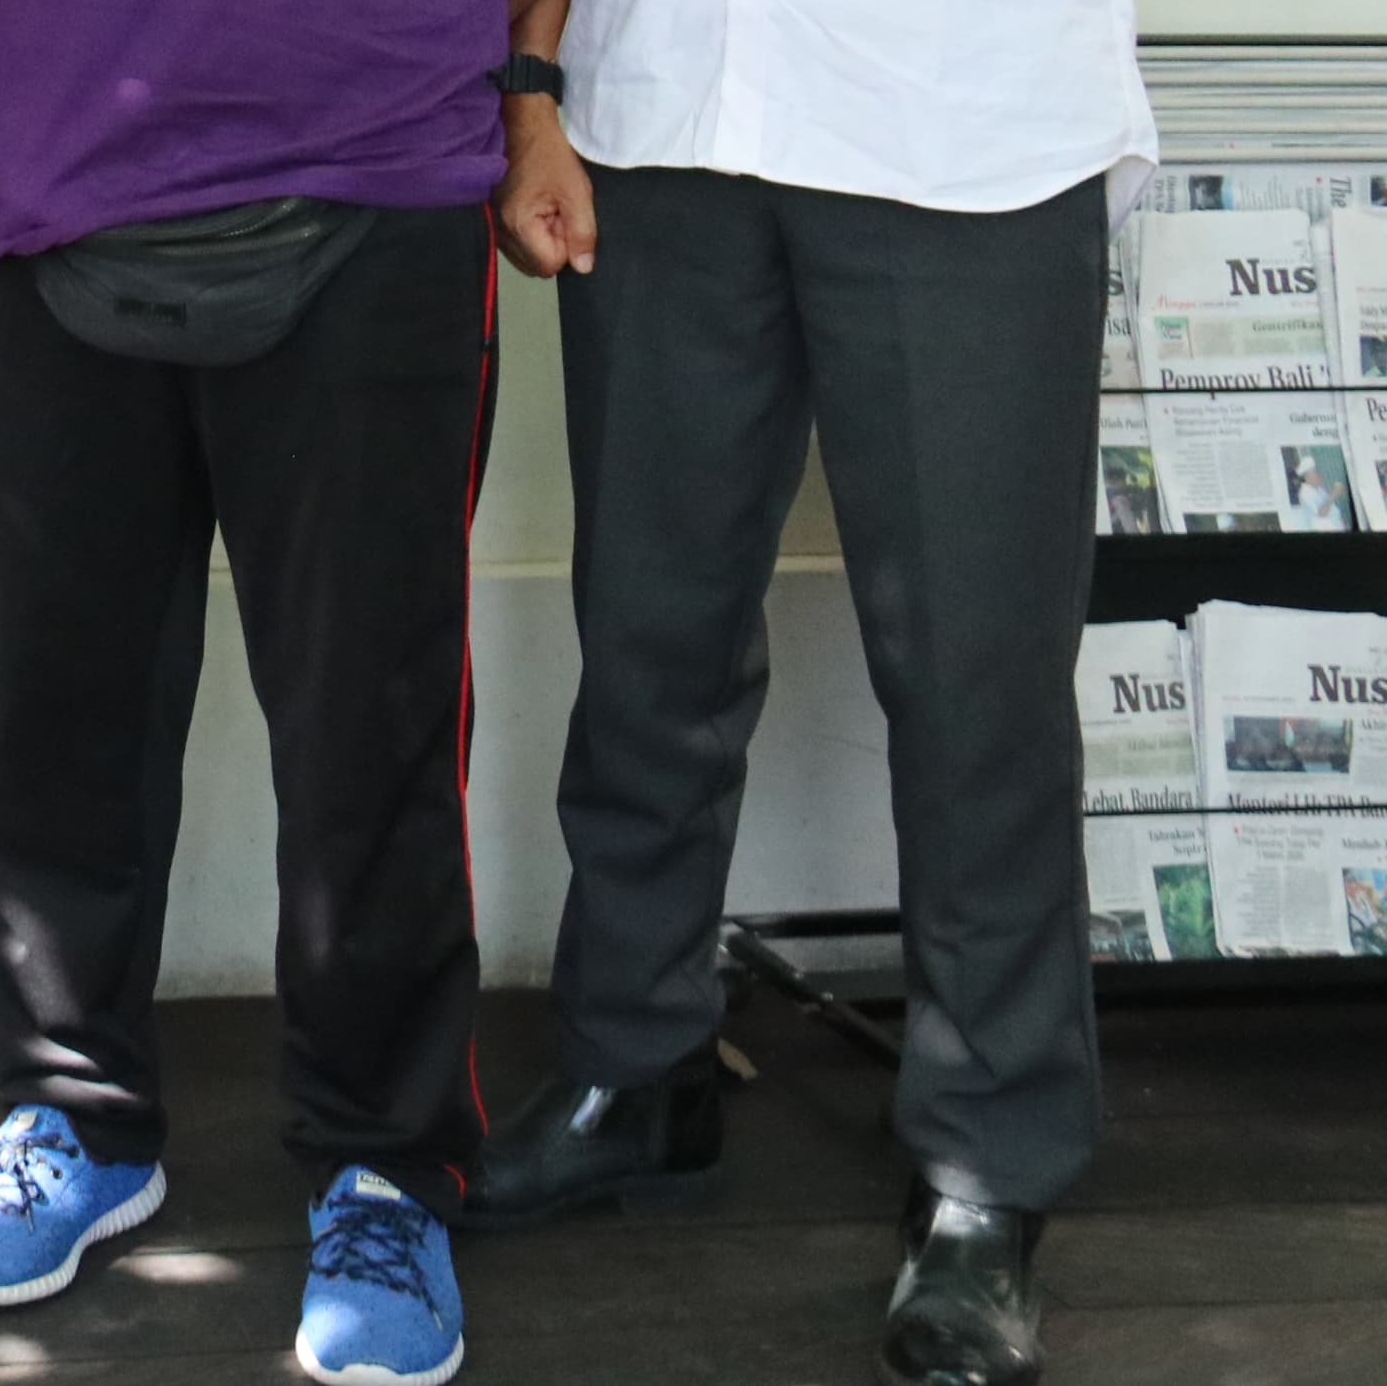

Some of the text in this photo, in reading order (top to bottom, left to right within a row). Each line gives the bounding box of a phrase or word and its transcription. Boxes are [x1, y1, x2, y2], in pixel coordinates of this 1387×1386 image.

[1225, 258, 1317, 296] Nus
[1160, 367, 1260, 401] Pemprov
[1268, 364, 1313, 389] Bali
[1110, 674, 1185, 714] Nus
[1307, 663, 1387, 705] Nus
